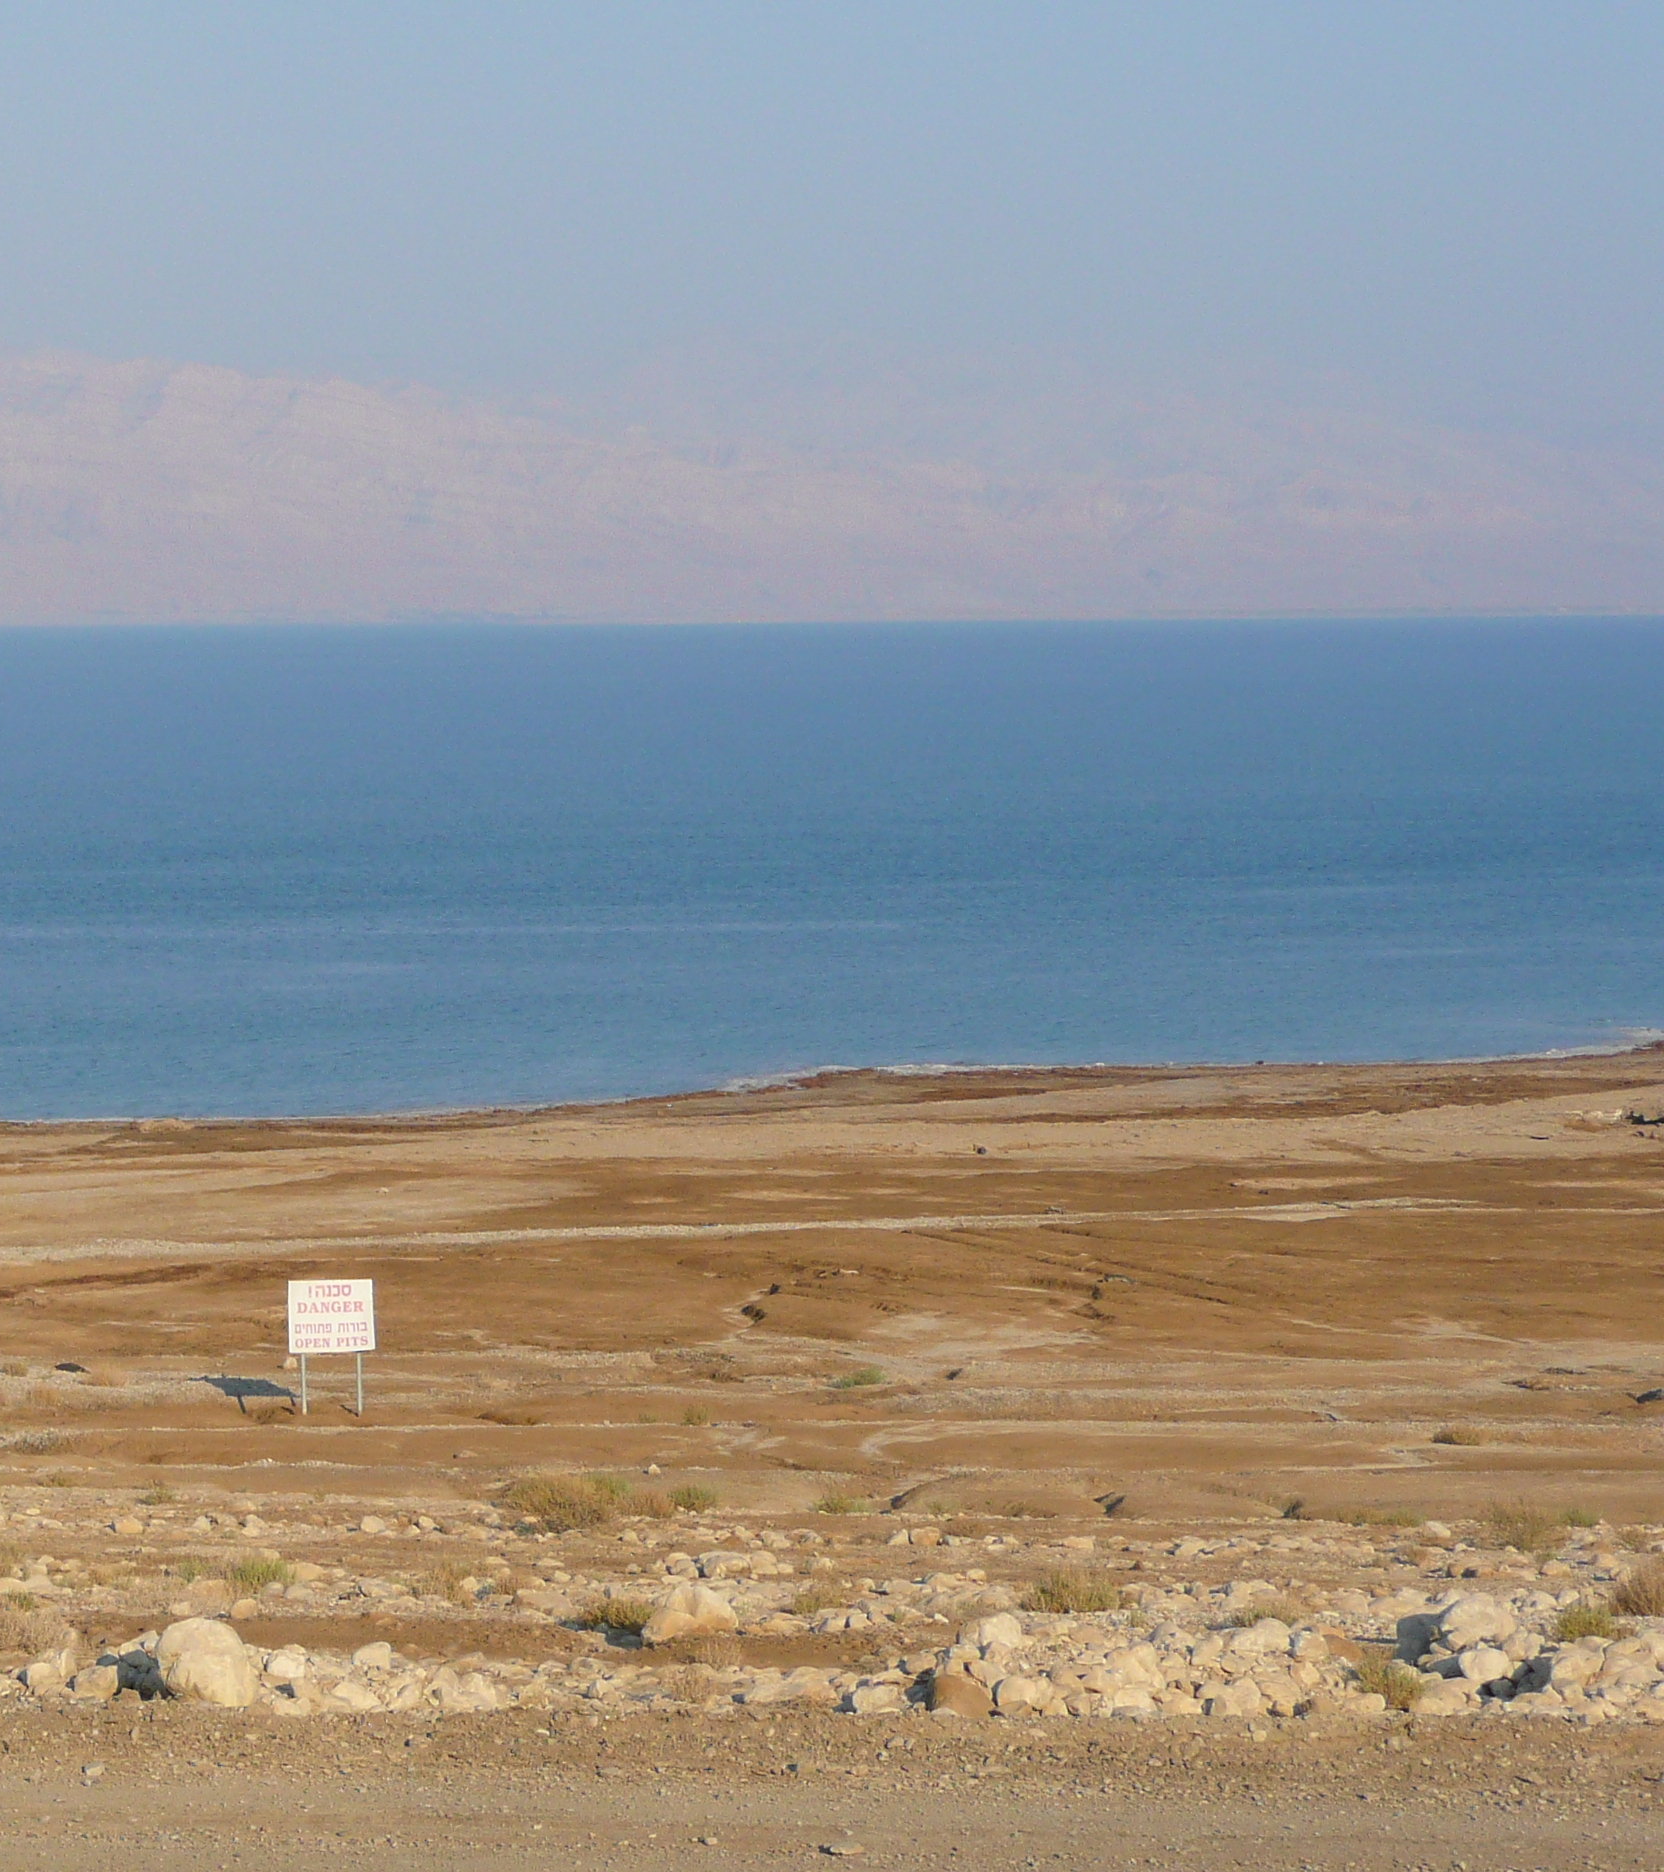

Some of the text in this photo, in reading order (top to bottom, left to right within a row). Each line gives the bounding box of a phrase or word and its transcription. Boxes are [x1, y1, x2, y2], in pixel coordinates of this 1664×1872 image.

[297, 1301, 364, 1314] DANGER
[294, 1322, 368, 1334] בורות פתוחים
[294, 1336, 368, 1349] OPEN PITS
